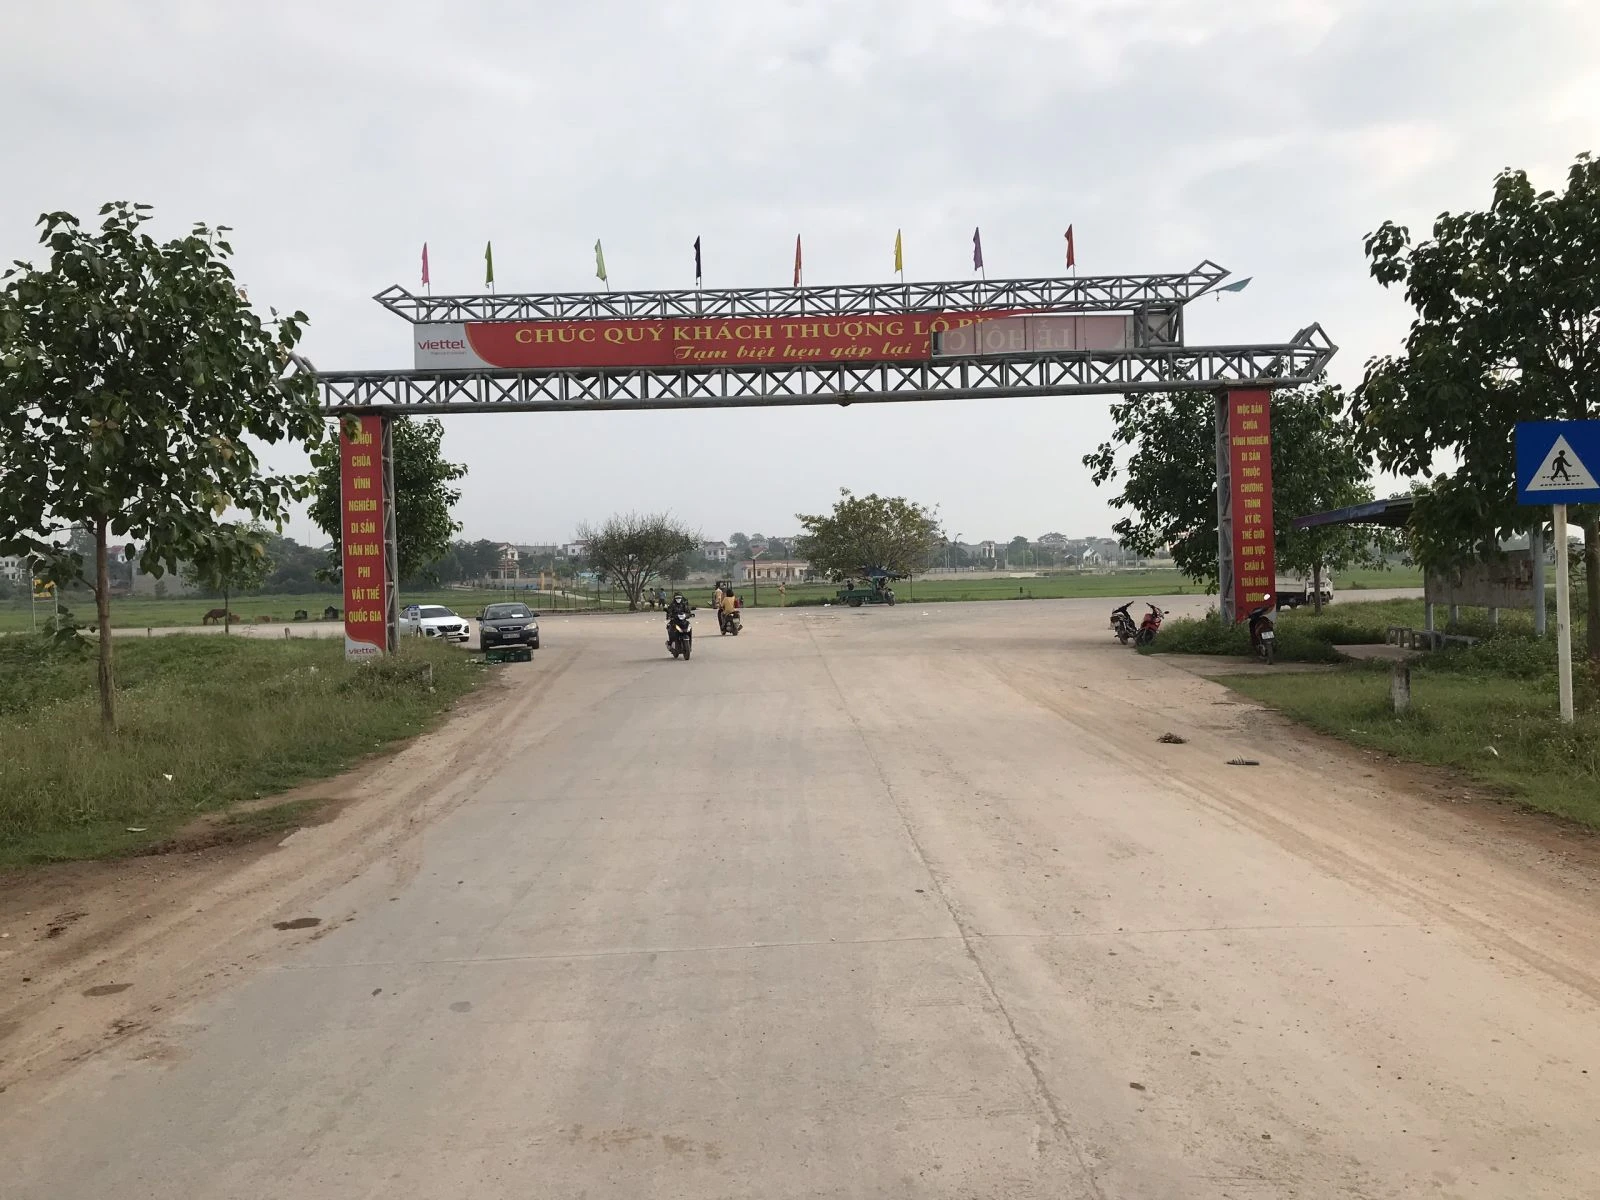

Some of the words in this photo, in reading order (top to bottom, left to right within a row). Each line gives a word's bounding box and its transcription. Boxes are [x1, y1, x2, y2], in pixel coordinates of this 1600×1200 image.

[515, 325, 596, 343] CHÚC
[604, 323, 665, 344] QUÝ
[673, 321, 773, 341] KHÁCH
[781, 320, 904, 340] THƯỢNG
[418, 339, 466, 350] viettel
[673, 345, 729, 361] Tạm
[736, 344, 776, 360] biệt
[783, 344, 823, 359] hẹn
[881, 341, 912, 357] lại
[921, 340, 931, 354] !
[351, 453, 371, 467] CHÙA
[1241, 452, 1248, 462] DI
[348, 498, 377, 512] NGHIÊM
[351, 522, 359, 534] DI
[360, 519, 376, 534] SẢN
[347, 542, 363, 556] VĂN
[357, 566, 371, 578] PHI
[351, 586, 366, 603] VẬT
[348, 607, 368, 623] QUỐC
[369, 610, 382, 622] GIA
